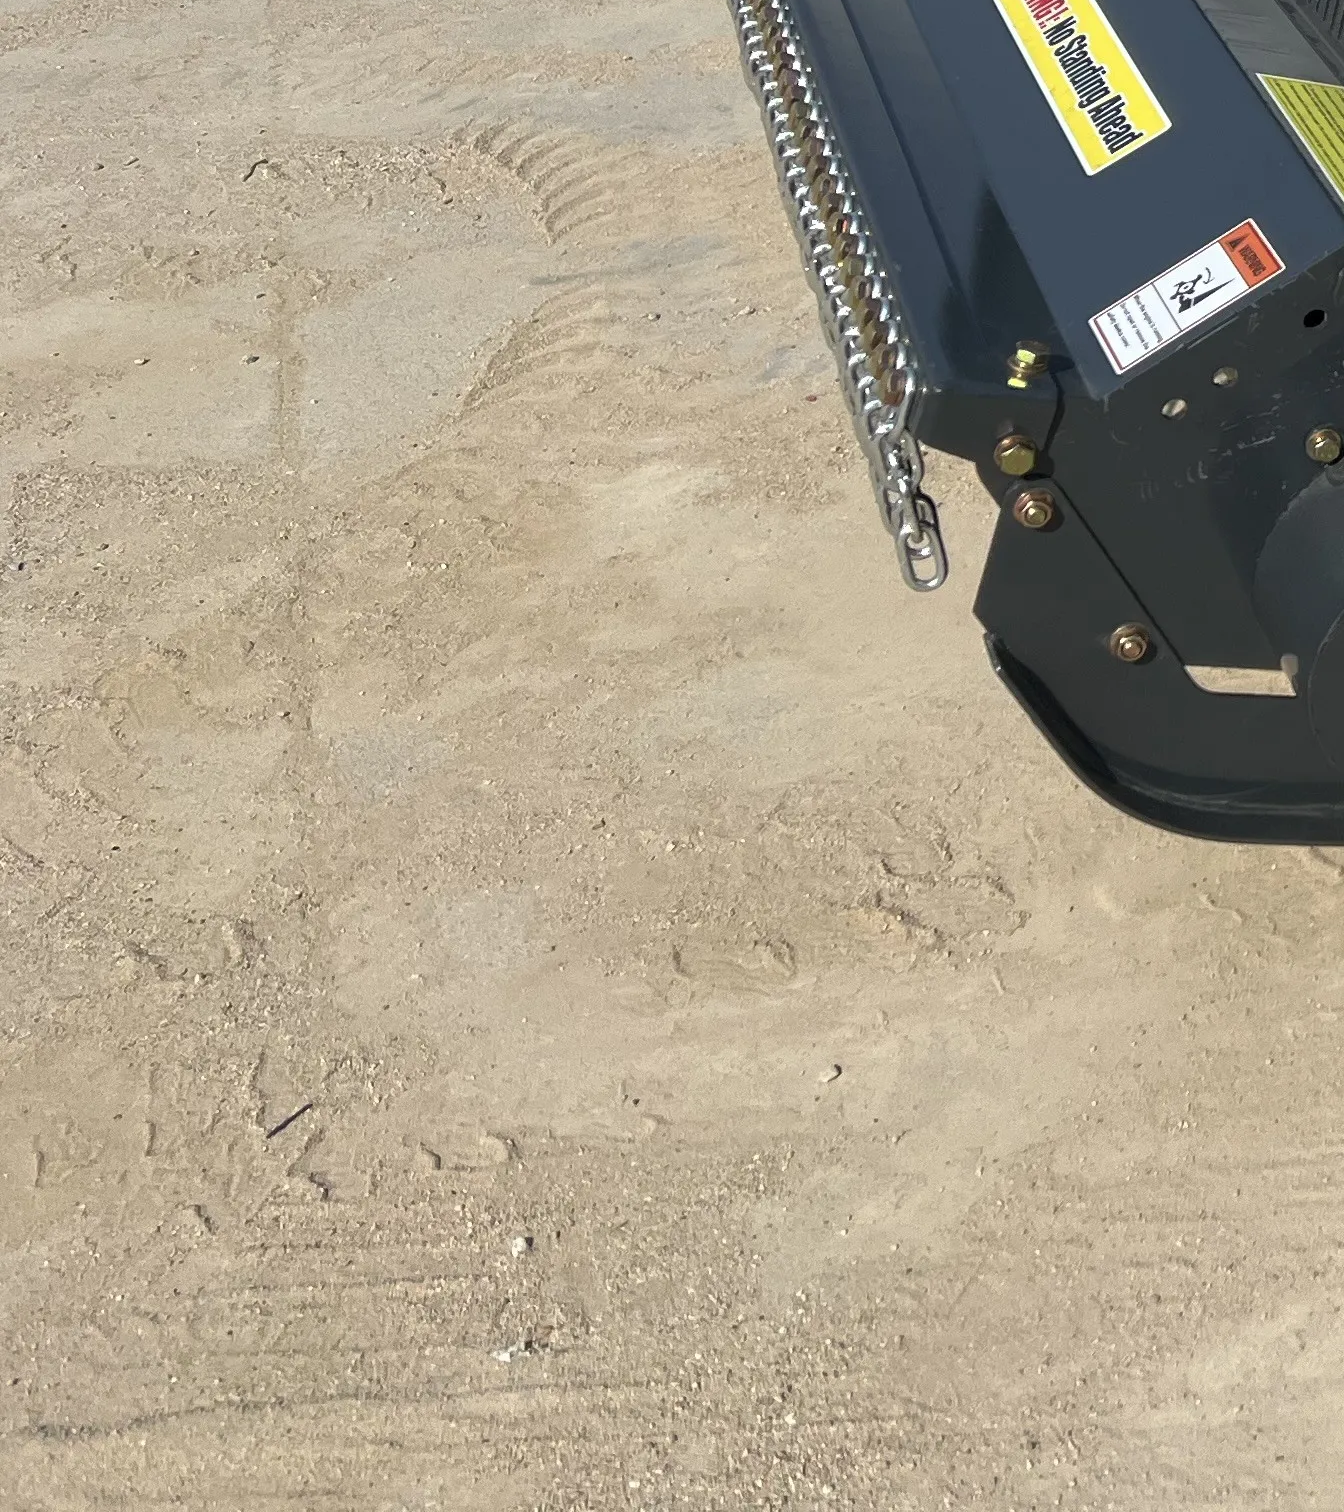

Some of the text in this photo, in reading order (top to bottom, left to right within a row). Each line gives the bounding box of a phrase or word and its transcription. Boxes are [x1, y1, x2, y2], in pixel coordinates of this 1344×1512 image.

[1043, 15, 1077, 46] No
[1053, 34, 1111, 109] Standing
[1086, 94, 1144, 155] Ahead
